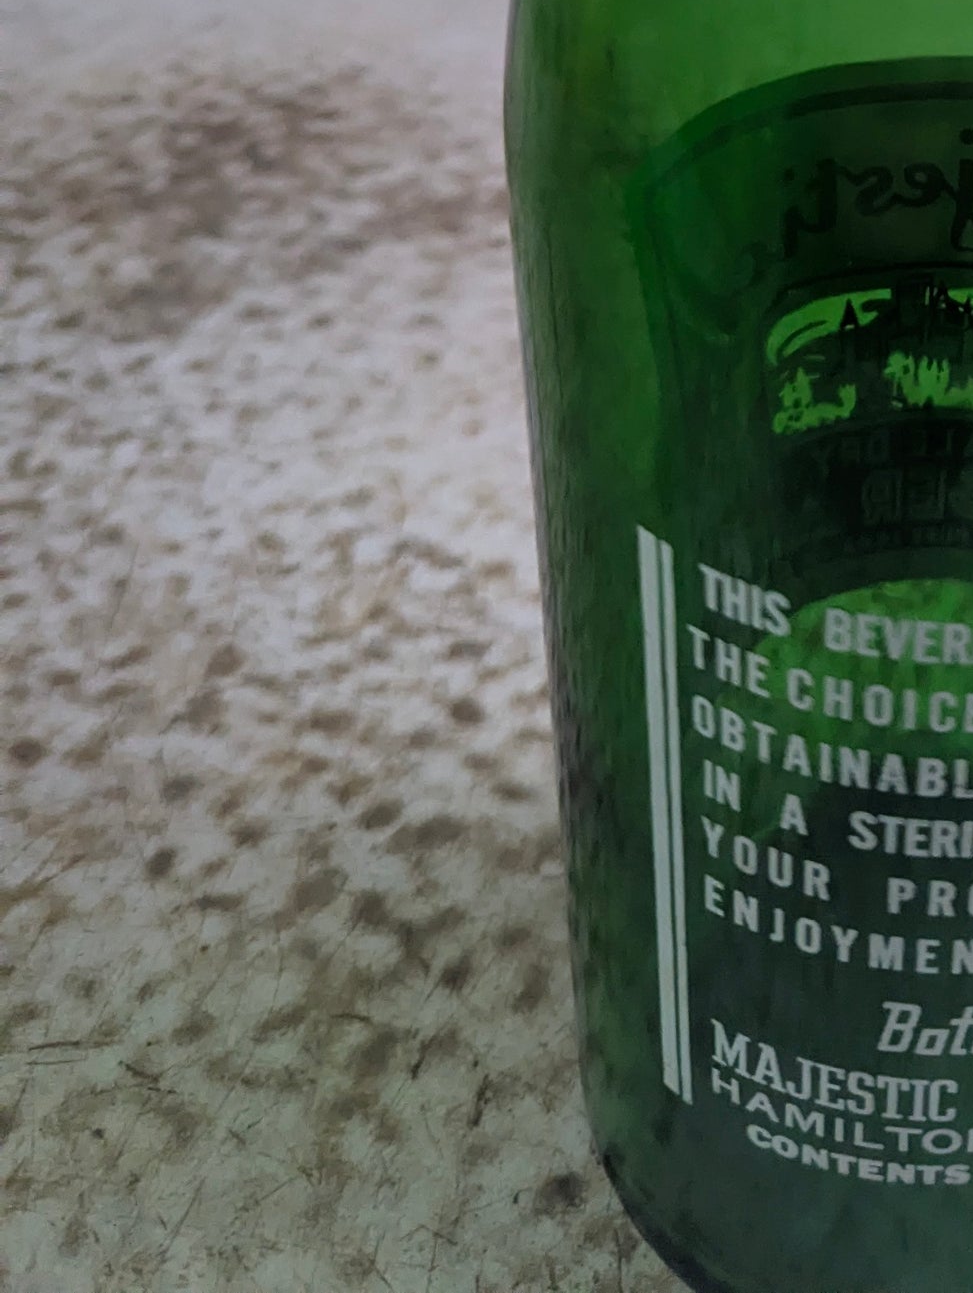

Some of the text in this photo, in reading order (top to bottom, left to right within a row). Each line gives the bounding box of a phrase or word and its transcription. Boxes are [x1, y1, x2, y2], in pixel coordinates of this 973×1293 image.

[700, 563, 791, 637] THIS
[687, 624, 771, 698] THE
[704, 758, 741, 812] IN
[780, 794, 809, 836] A
[701, 816, 830, 901] YOUR
[710, 1018, 958, 1122] MAJESTIC
[746, 1124, 970, 1185] CONTENTS
